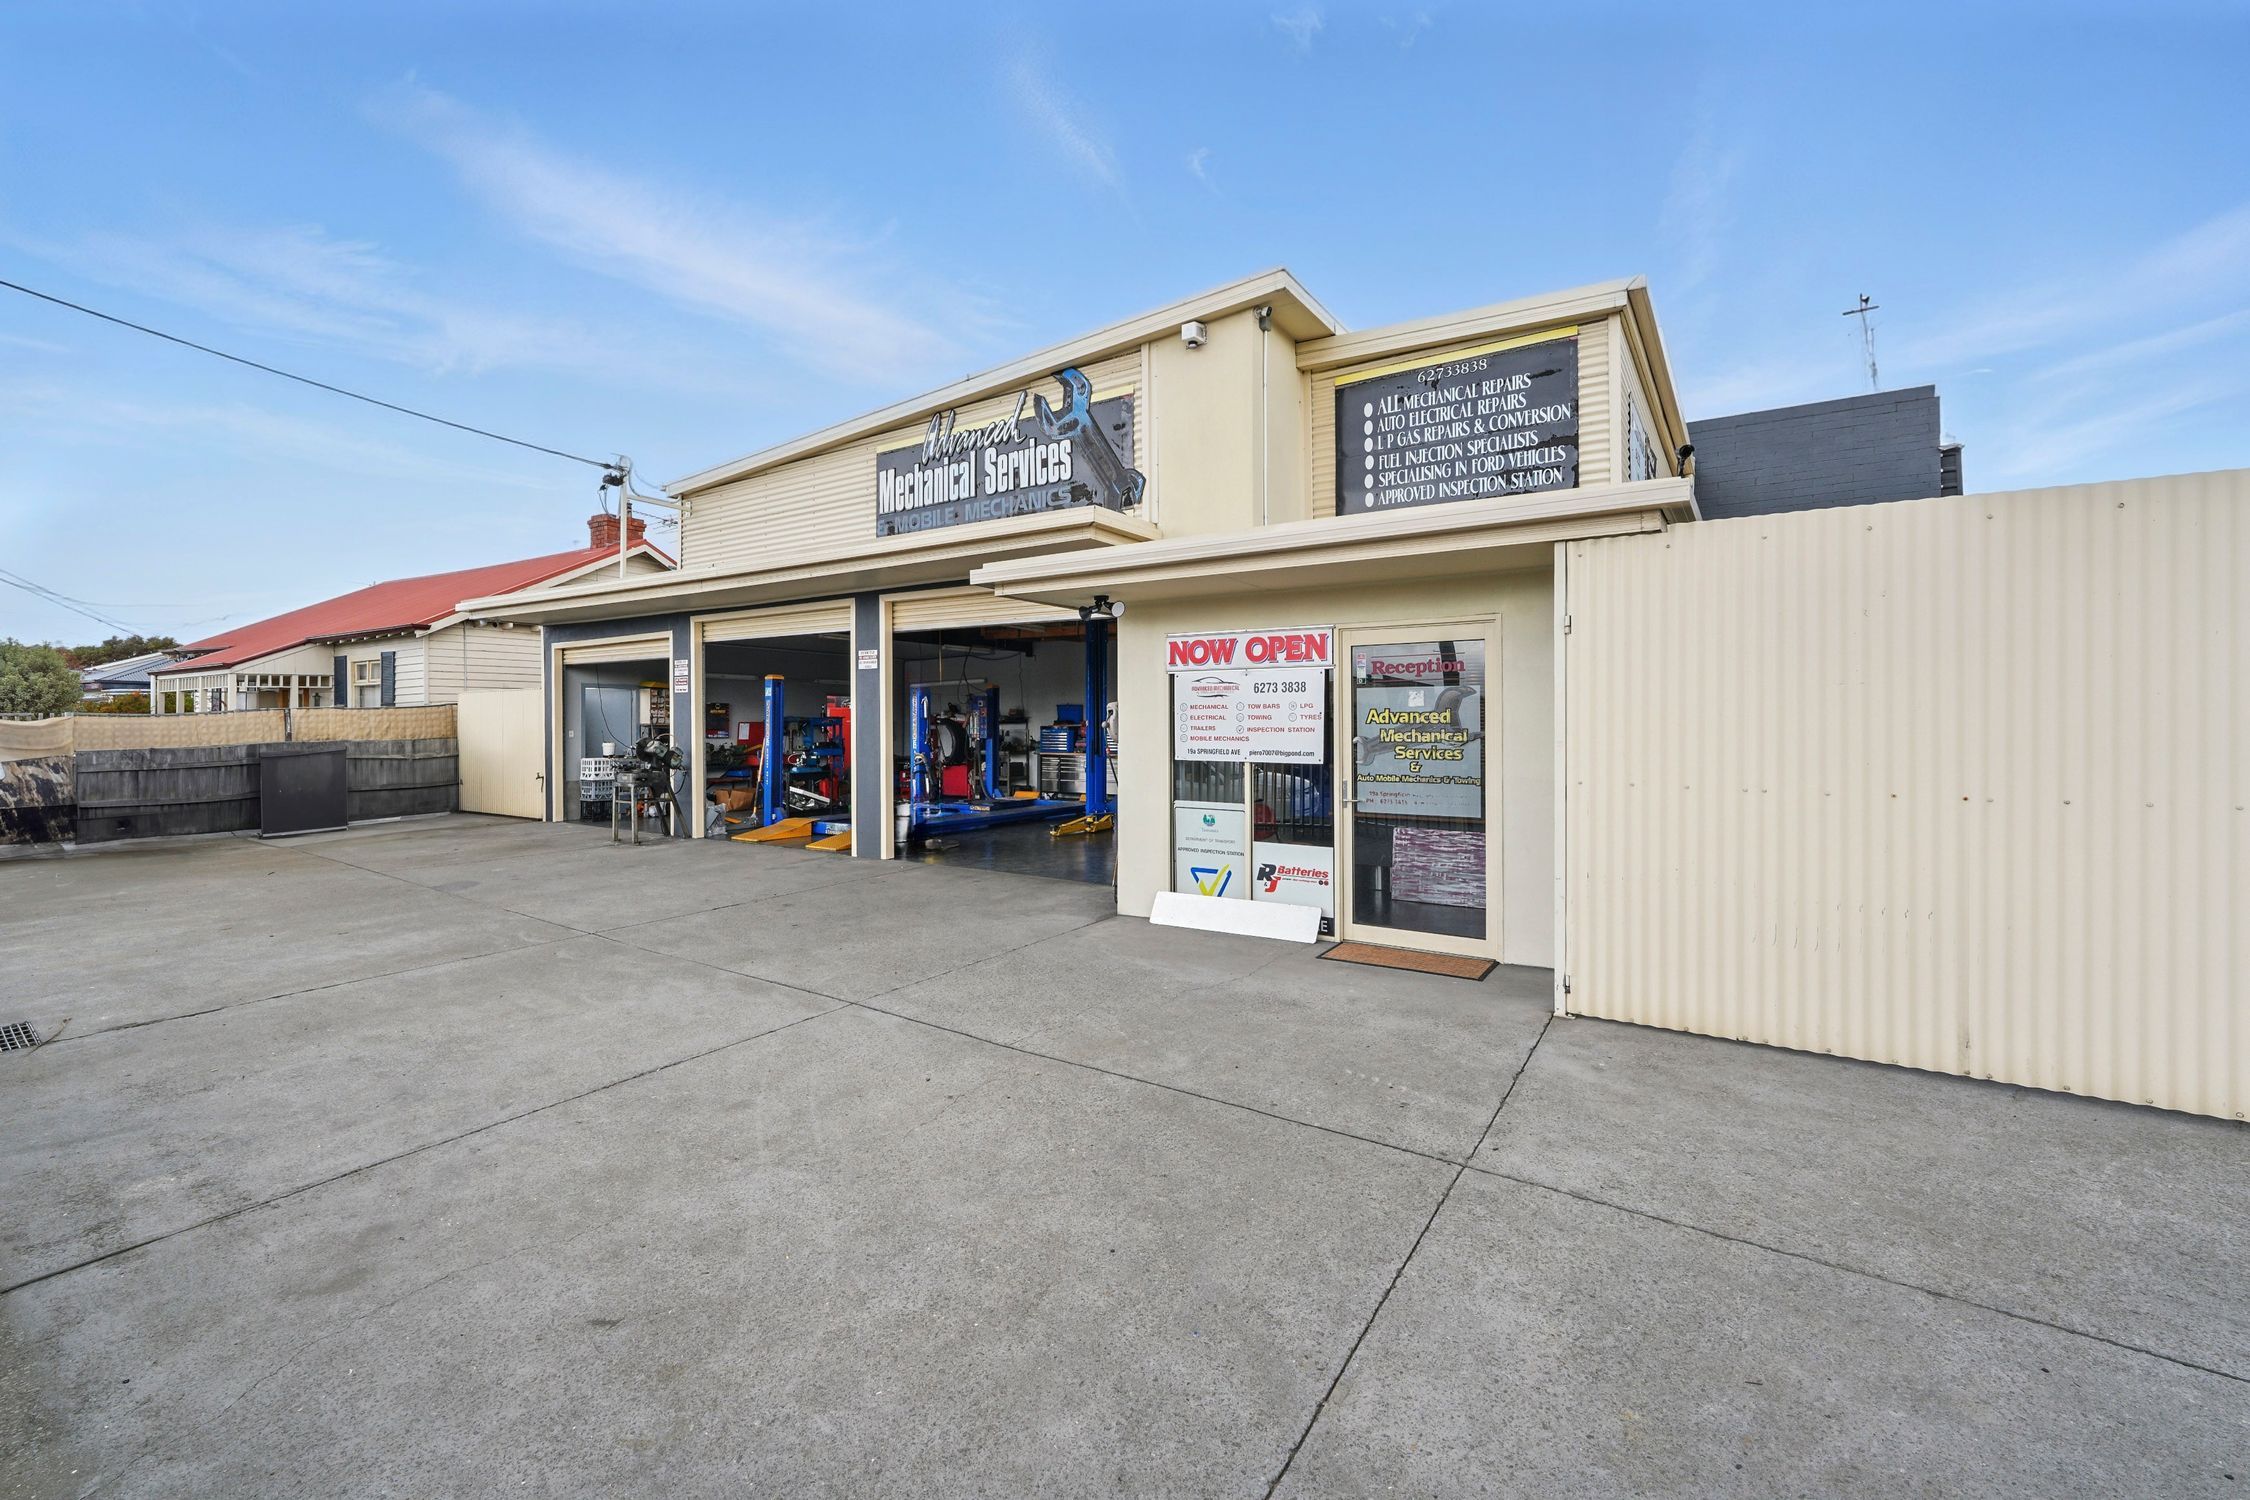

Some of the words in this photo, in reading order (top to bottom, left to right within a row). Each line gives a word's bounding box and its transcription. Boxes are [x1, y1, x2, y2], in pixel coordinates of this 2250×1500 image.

[1417, 358, 1488, 383] 62733838
[1378, 398, 1402, 416] ALL
[1404, 384, 1478, 411] MECHANICAL
[1482, 372, 1532, 396] REPAIRS
[921, 390, 1027, 466] Advanced
[1378, 414, 1406, 433] AUTO
[1409, 402, 1472, 426] ELECTRICAL
[1478, 392, 1527, 414] REPAIRS
[1378, 434, 1384, 450] L
[1387, 433, 1394, 448] P
[1397, 428, 1420, 446] GAS
[1424, 420, 1470, 441] REPAIRS
[1474, 418, 1485, 434] &
[1488, 402, 1572, 432] CONVERSION
[1379, 454, 1402, 470] FUEL
[1406, 442, 1463, 466] INJECTION
[1467, 430, 1538, 456] SPECIALISTS
[879, 450, 977, 514] Mechanical
[984, 438, 1073, 495] Services
[1378, 462, 1451, 488] SPECIALISING
[1455, 460, 1468, 477] IN
[1472, 454, 1504, 474] FORD
[1508, 445, 1566, 468] VEHICLES
[1378, 483, 1436, 506] APPROVED
[1439, 472, 1508, 498] INSPECTION
[1512, 467, 1564, 488] STATION
[894, 507, 956, 532] MOBILE
[964, 486, 1072, 521] MECHANICS
[1168, 638, 1238, 666] NOW
[1245, 634, 1330, 664] OPEN
[1371, 658, 1466, 677] Reception
[1254, 682, 1278, 694] 6273
[1282, 682, 1307, 693] 3838
[1366, 708, 1451, 724] Advanced
[1380, 728, 1468, 743] Mechanical
[1395, 745, 1464, 760] Services
[1409, 761, 1423, 773] &
[1357, 774, 1374, 782] Auto
[1376, 774, 1400, 783] Mobile
[1401, 774, 1441, 784] Mechanics
[1453, 776, 1481, 786] Towing
[1277, 866, 1328, 878] Batteries
